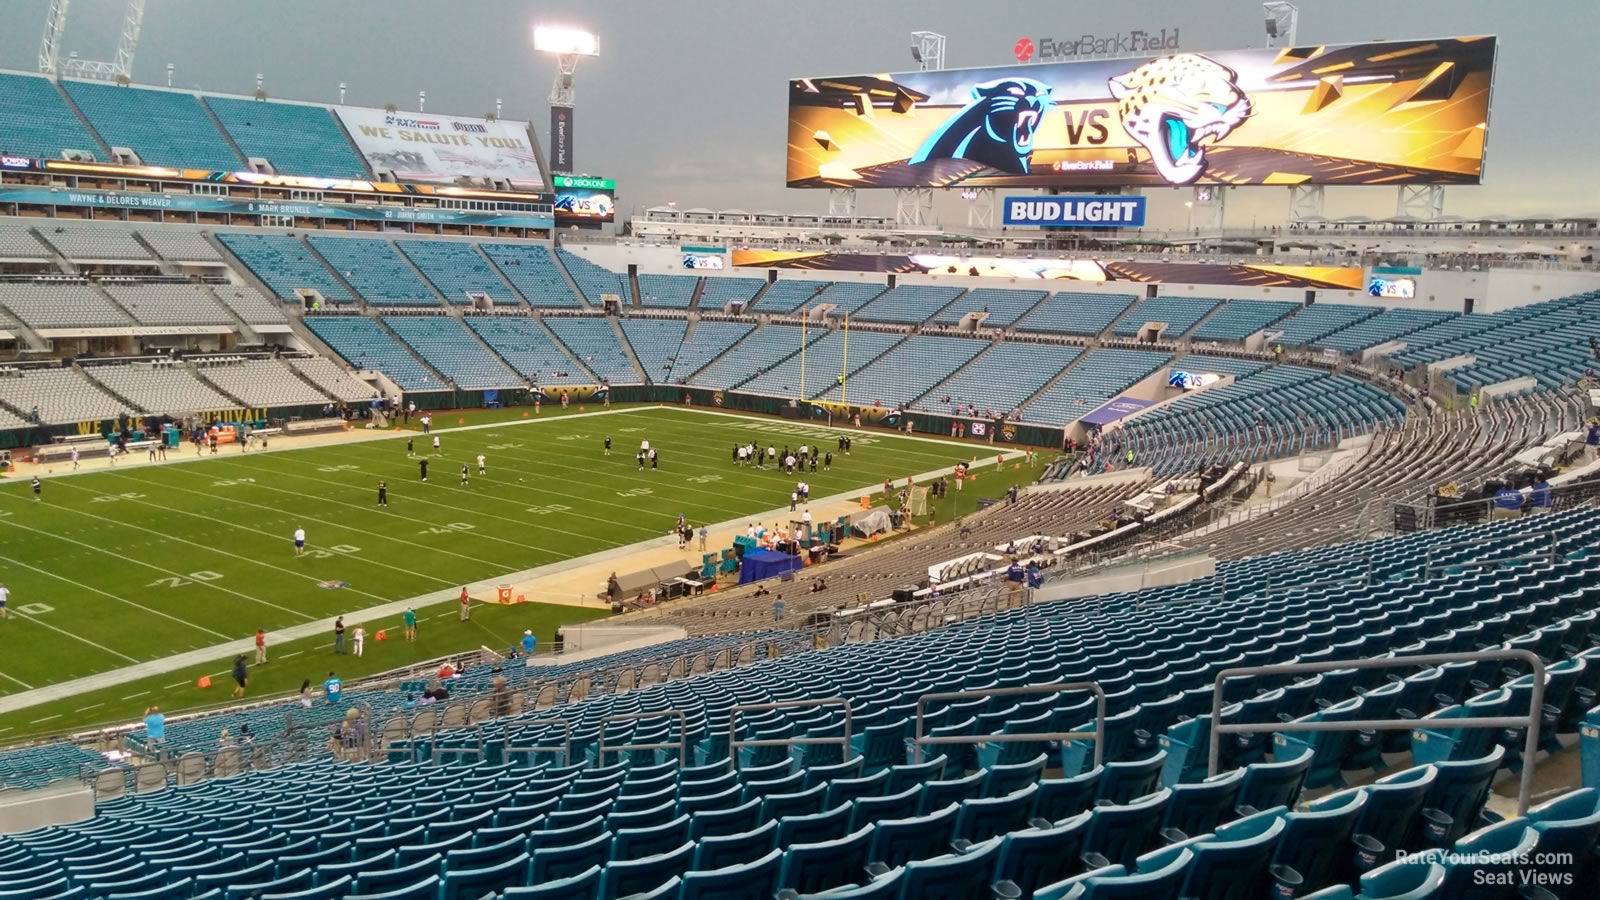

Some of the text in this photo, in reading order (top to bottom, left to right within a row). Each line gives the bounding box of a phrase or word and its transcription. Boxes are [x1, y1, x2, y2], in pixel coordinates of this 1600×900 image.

[385, 115, 417, 124] Navy
[396, 121, 440, 130] Mutual
[1064, 109, 1110, 145] VS
[358, 125, 523, 149] WE SALUTE YOU!
[69, 193, 97, 203] WAYNE
[99, 195, 104, 204] &
[106, 195, 139, 206] DELORES
[141, 198, 171, 207] WEAVER
[577, 199, 591, 210] VS
[248, 203, 254, 212] 8
[258, 204, 279, 213] MARK
[280, 205, 311, 214] BRUNELL
[1010, 201, 1138, 221] BUD LIGHT
[397, 212, 416, 220] JIMMY
[698, 259, 708, 267] VS
[1386, 284, 1397, 294] VS
[1190, 376, 1203, 387] VS
[525, 503, 573, 515] 50
[430, 522, 476, 534] 40
[302, 544, 362, 559] 30
[154, 569, 225, 588] 20
[328, 683, 340, 694] 90
